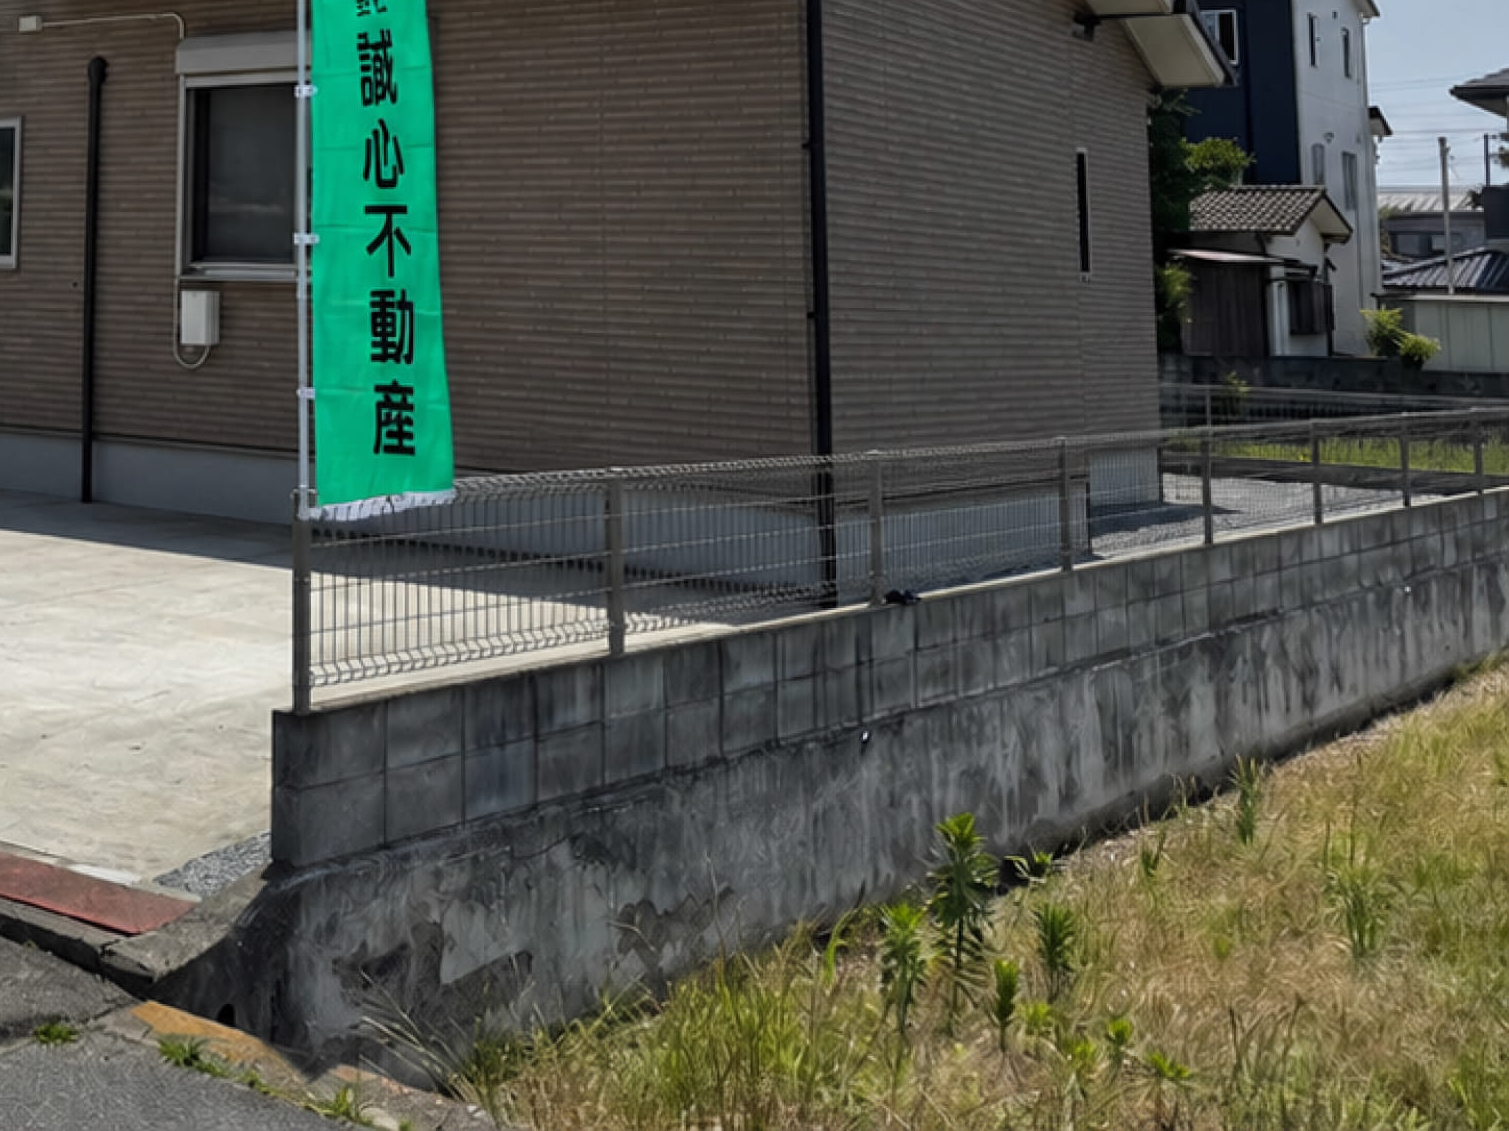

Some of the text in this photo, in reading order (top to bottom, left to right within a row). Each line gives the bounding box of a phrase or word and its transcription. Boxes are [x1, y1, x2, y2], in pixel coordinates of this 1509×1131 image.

[356, 28, 416, 456] 誠心不動産
